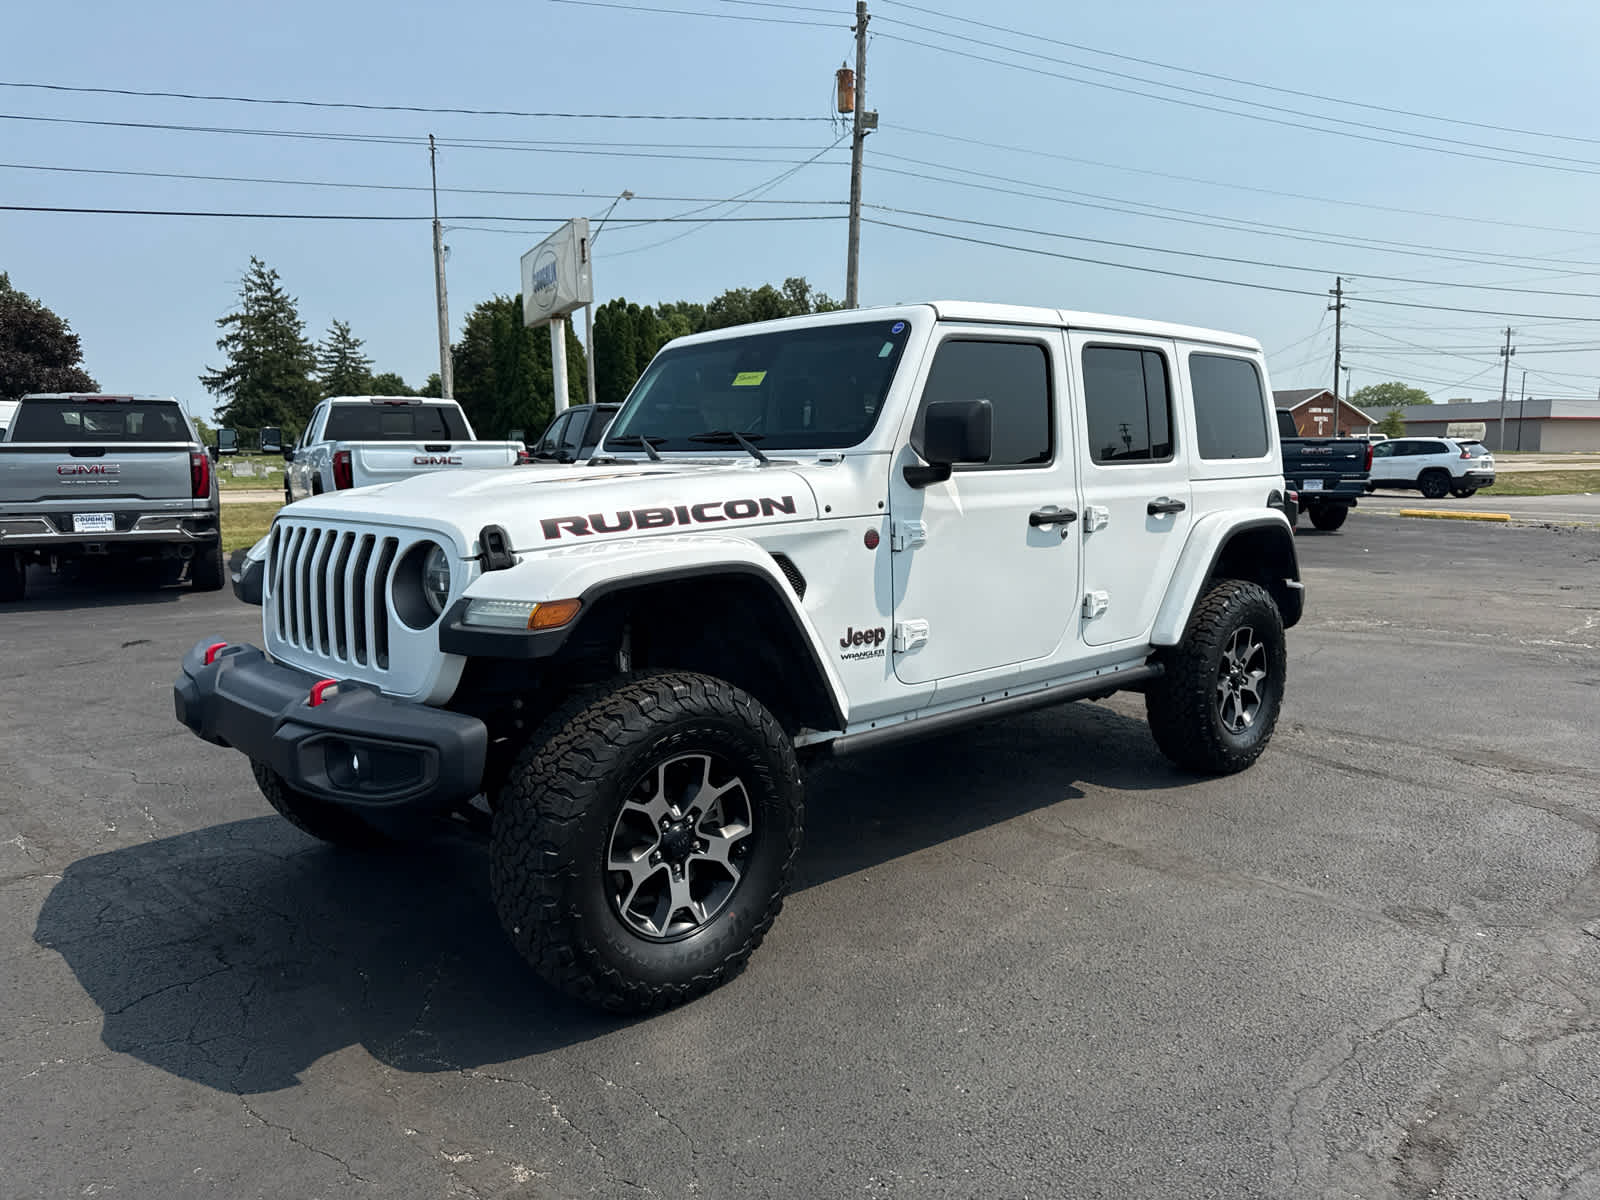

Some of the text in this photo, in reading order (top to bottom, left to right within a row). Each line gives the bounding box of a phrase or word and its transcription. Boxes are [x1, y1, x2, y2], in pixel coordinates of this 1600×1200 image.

[413, 456, 463, 465] GMC
[57, 464, 120, 475] GMC
[540, 495, 797, 540] RUBICON
[840, 627, 886, 648] Jeep
[841, 649, 886, 660] WRANGLER
